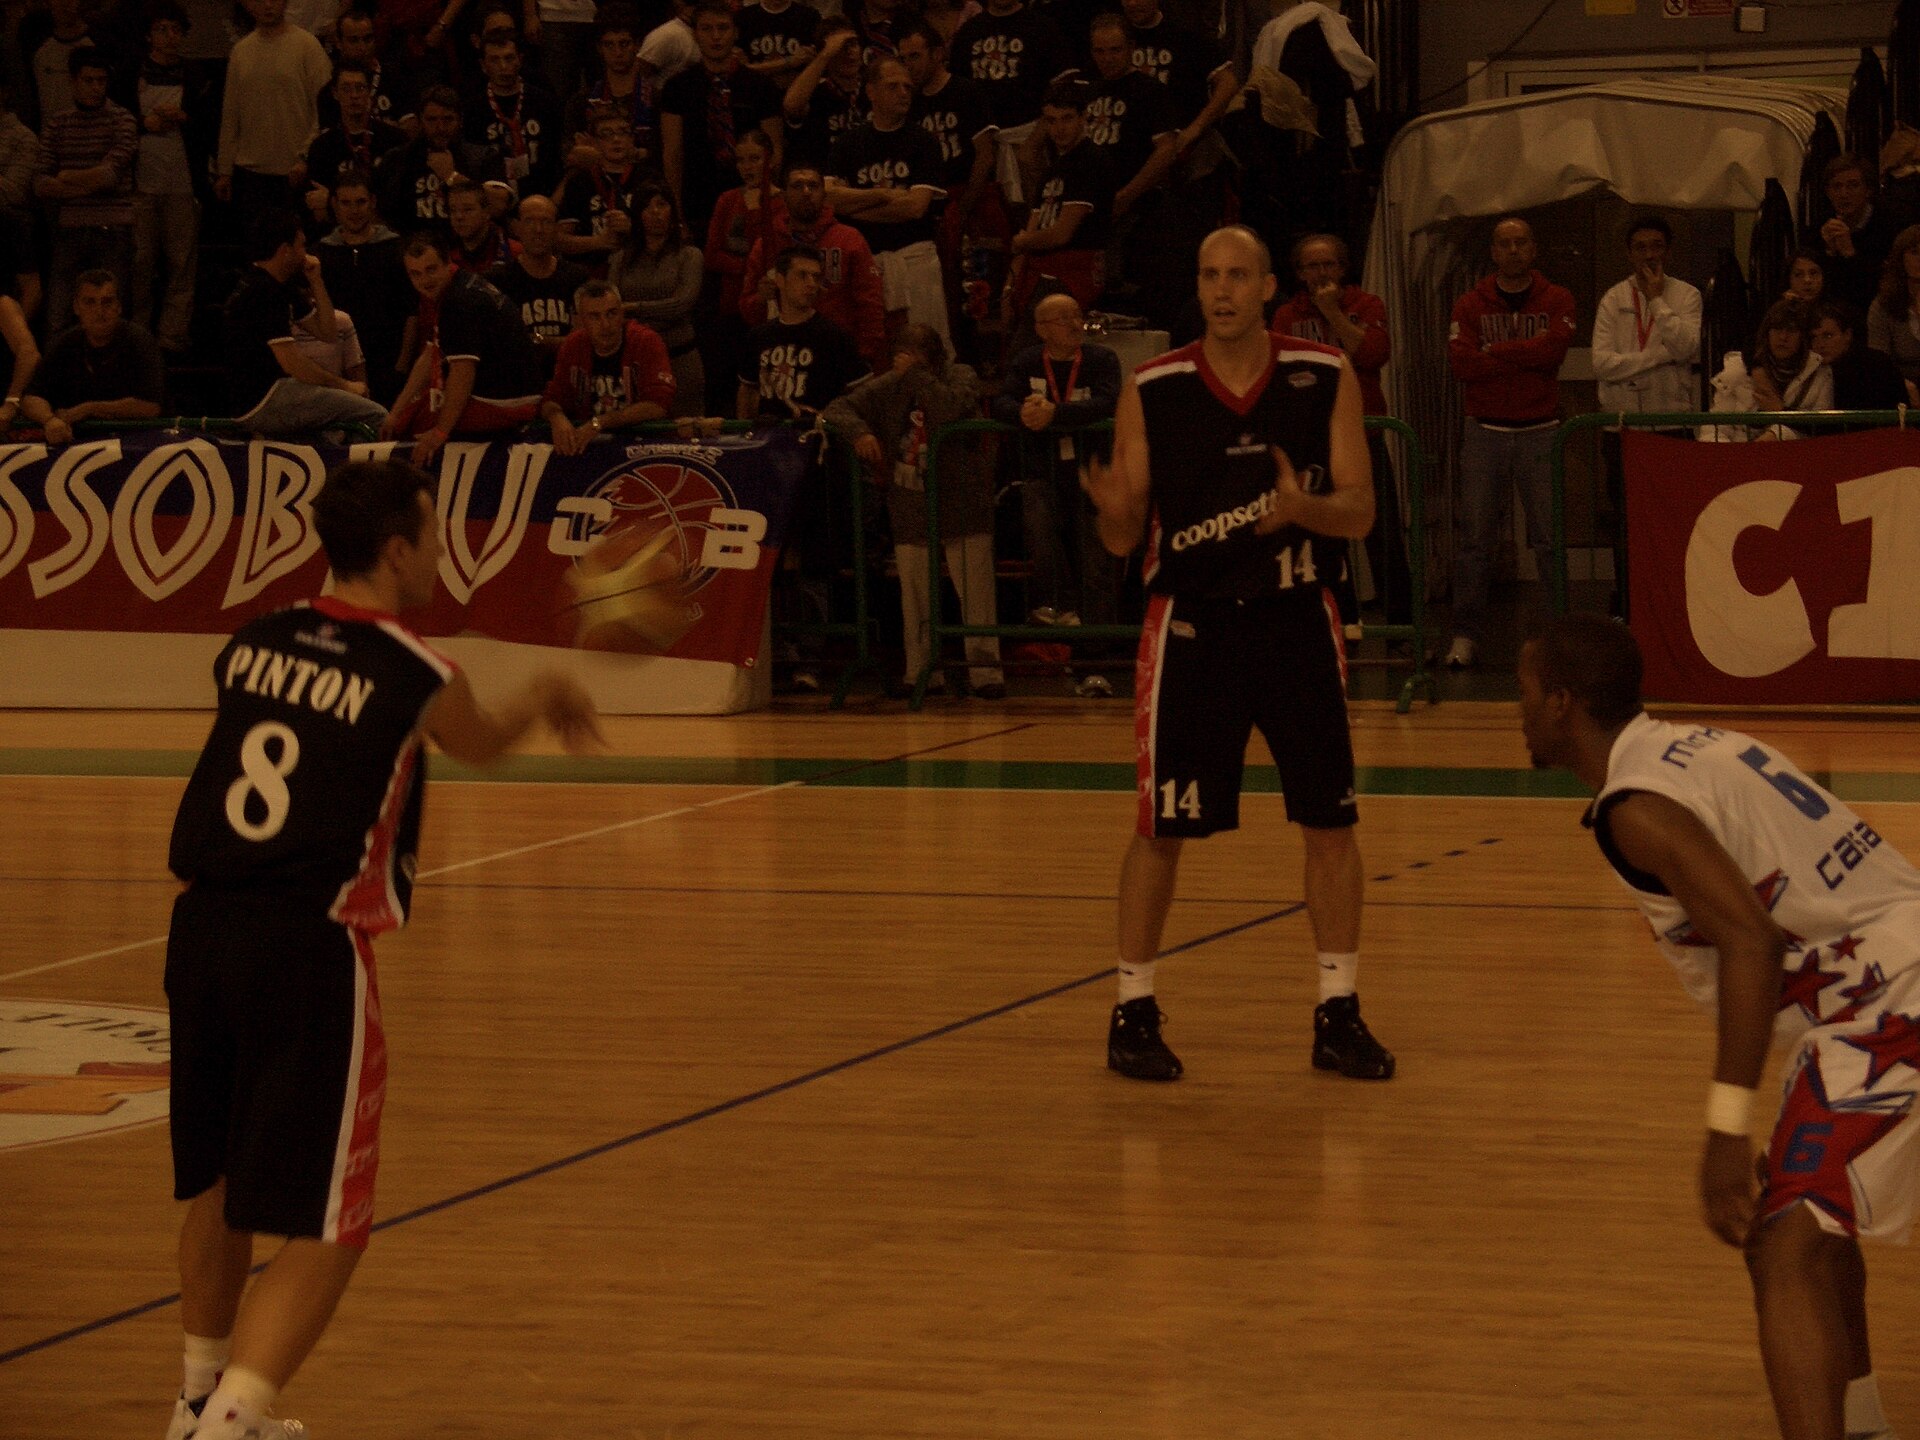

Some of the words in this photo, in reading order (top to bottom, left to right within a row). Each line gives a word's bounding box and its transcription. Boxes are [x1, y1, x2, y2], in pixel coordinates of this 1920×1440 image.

[971, 35, 1024, 56] SOLO
[1131, 46, 1173, 67] OLO
[856, 160, 910, 185] SOLO
[760, 343, 814, 368] SOLO
[1275, 538, 1318, 590] 14
[225, 644, 375, 726] PINTON
[225, 720, 300, 842] 8
[1159, 778, 1202, 819] 14
[1737, 745, 1830, 821] 6
[1782, 1122, 1834, 1173] 6
